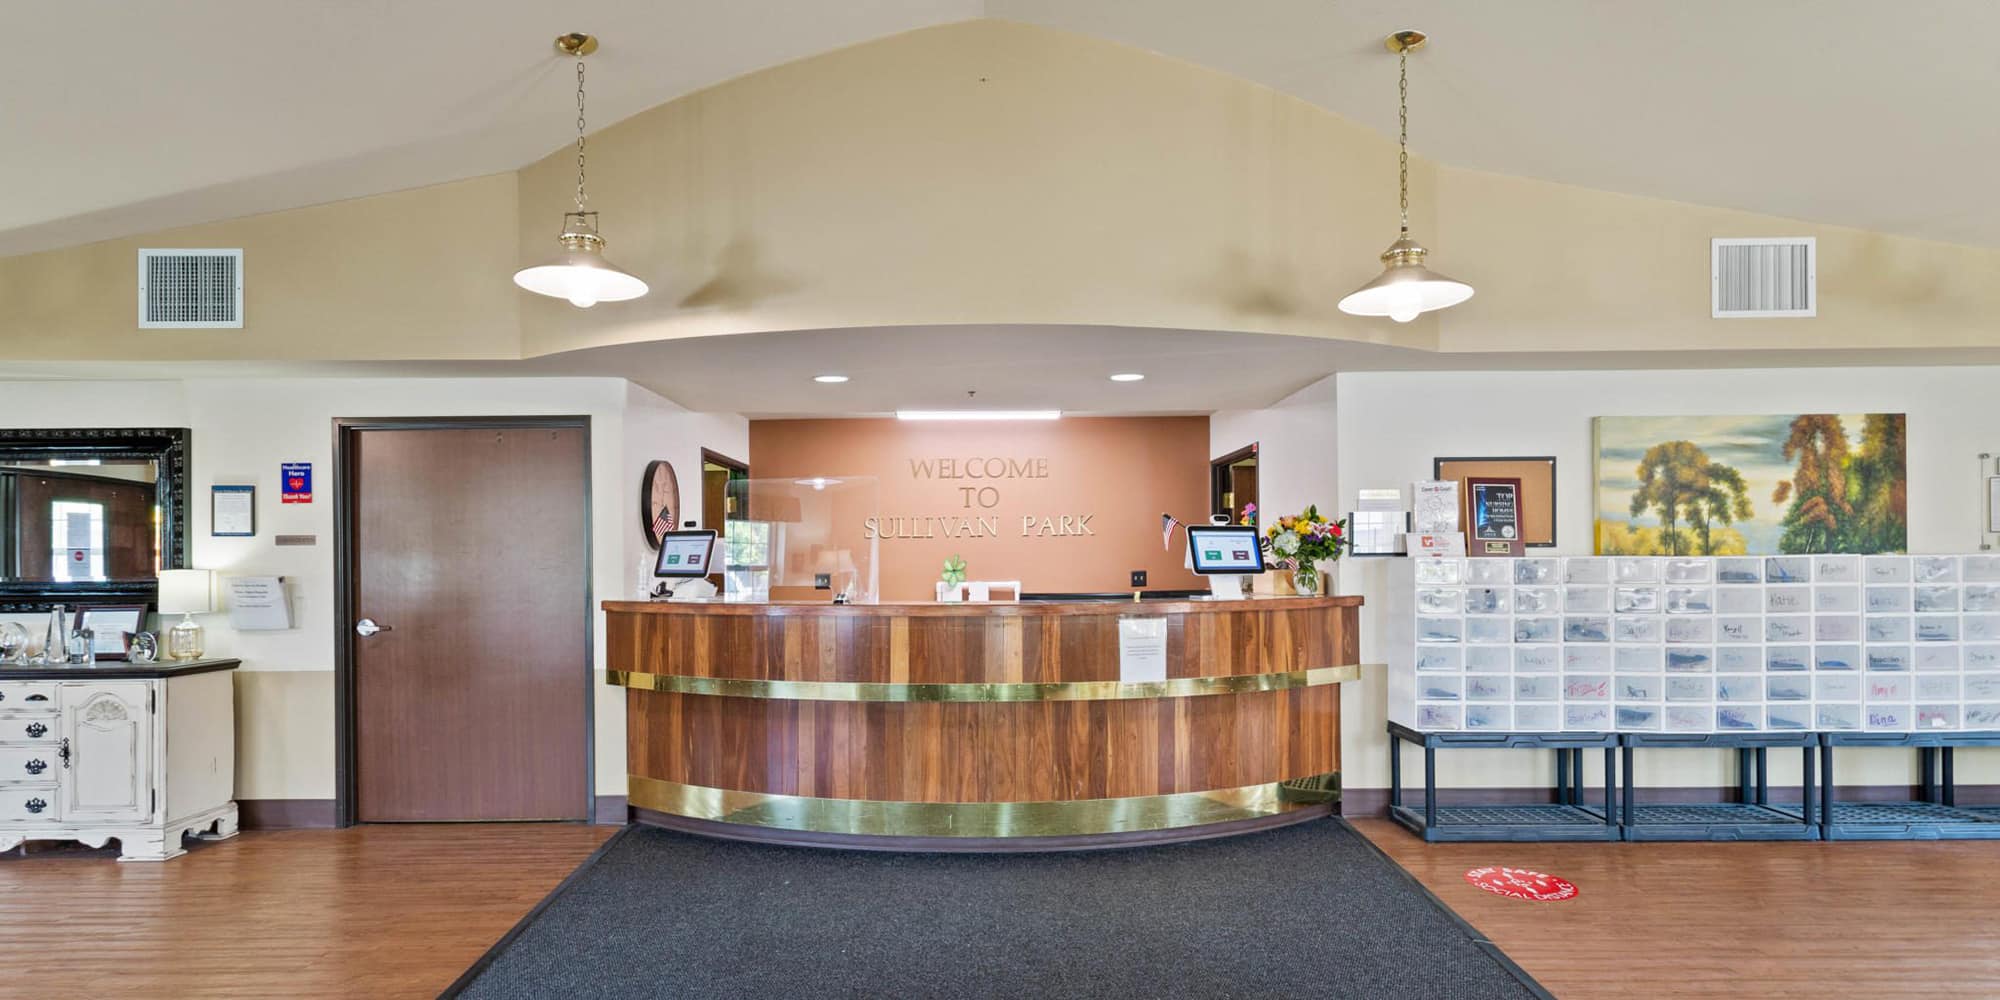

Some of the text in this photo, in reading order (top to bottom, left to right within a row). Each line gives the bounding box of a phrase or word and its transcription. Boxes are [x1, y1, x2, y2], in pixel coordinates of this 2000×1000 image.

[908, 457, 1049, 479] WELCOME
[958, 486, 1000, 509] TO
[864, 512, 1096, 539] SULLIVAN PARK
[1474, 881, 1531, 900] SOCIAL
